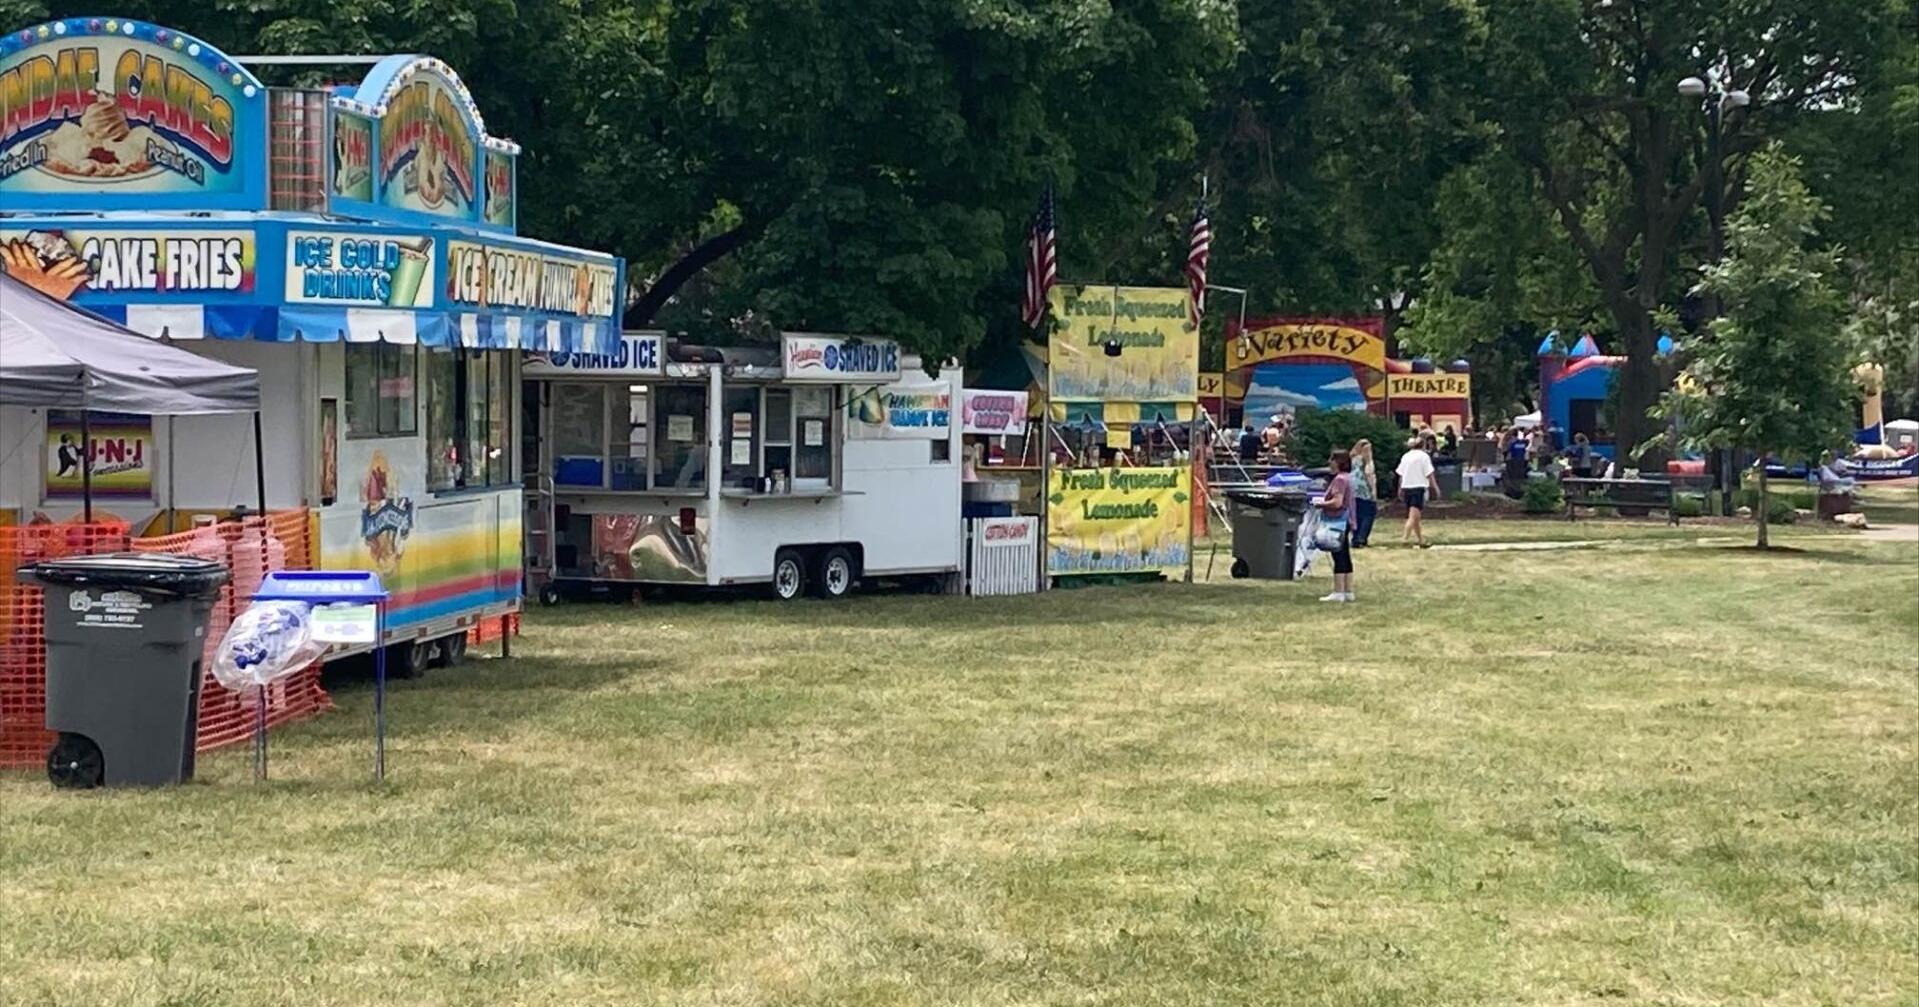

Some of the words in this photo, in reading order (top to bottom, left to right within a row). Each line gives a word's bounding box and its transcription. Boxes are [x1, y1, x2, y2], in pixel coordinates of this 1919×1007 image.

[115, 49, 234, 165] CAKES
[0, 144, 33, 177] ried
[148, 138, 184, 173] Peanut
[185, 161, 205, 185] Oil
[83, 237, 158, 290] CAKE
[165, 237, 244, 291] FRIES
[295, 236, 333, 268] ICE
[340, 237, 400, 271] COLD
[303, 267, 392, 302] DRINKS
[453, 246, 482, 304] ICE
[485, 250, 540, 308] CREAM
[1063, 295, 1112, 317] Fresh
[571, 339, 629, 370] SHAVED
[633, 339, 657, 370] ICE
[1247, 325, 1369, 357] Variety
[838, 344, 880, 374] SHAVED
[881, 345, 898, 373] ICE
[1391, 375, 1468, 395] THEATRE
[1061, 470, 1105, 491] Fresh
[1109, 468, 1179, 495] Squeezed
[1081, 499, 1159, 520] Lemonade
